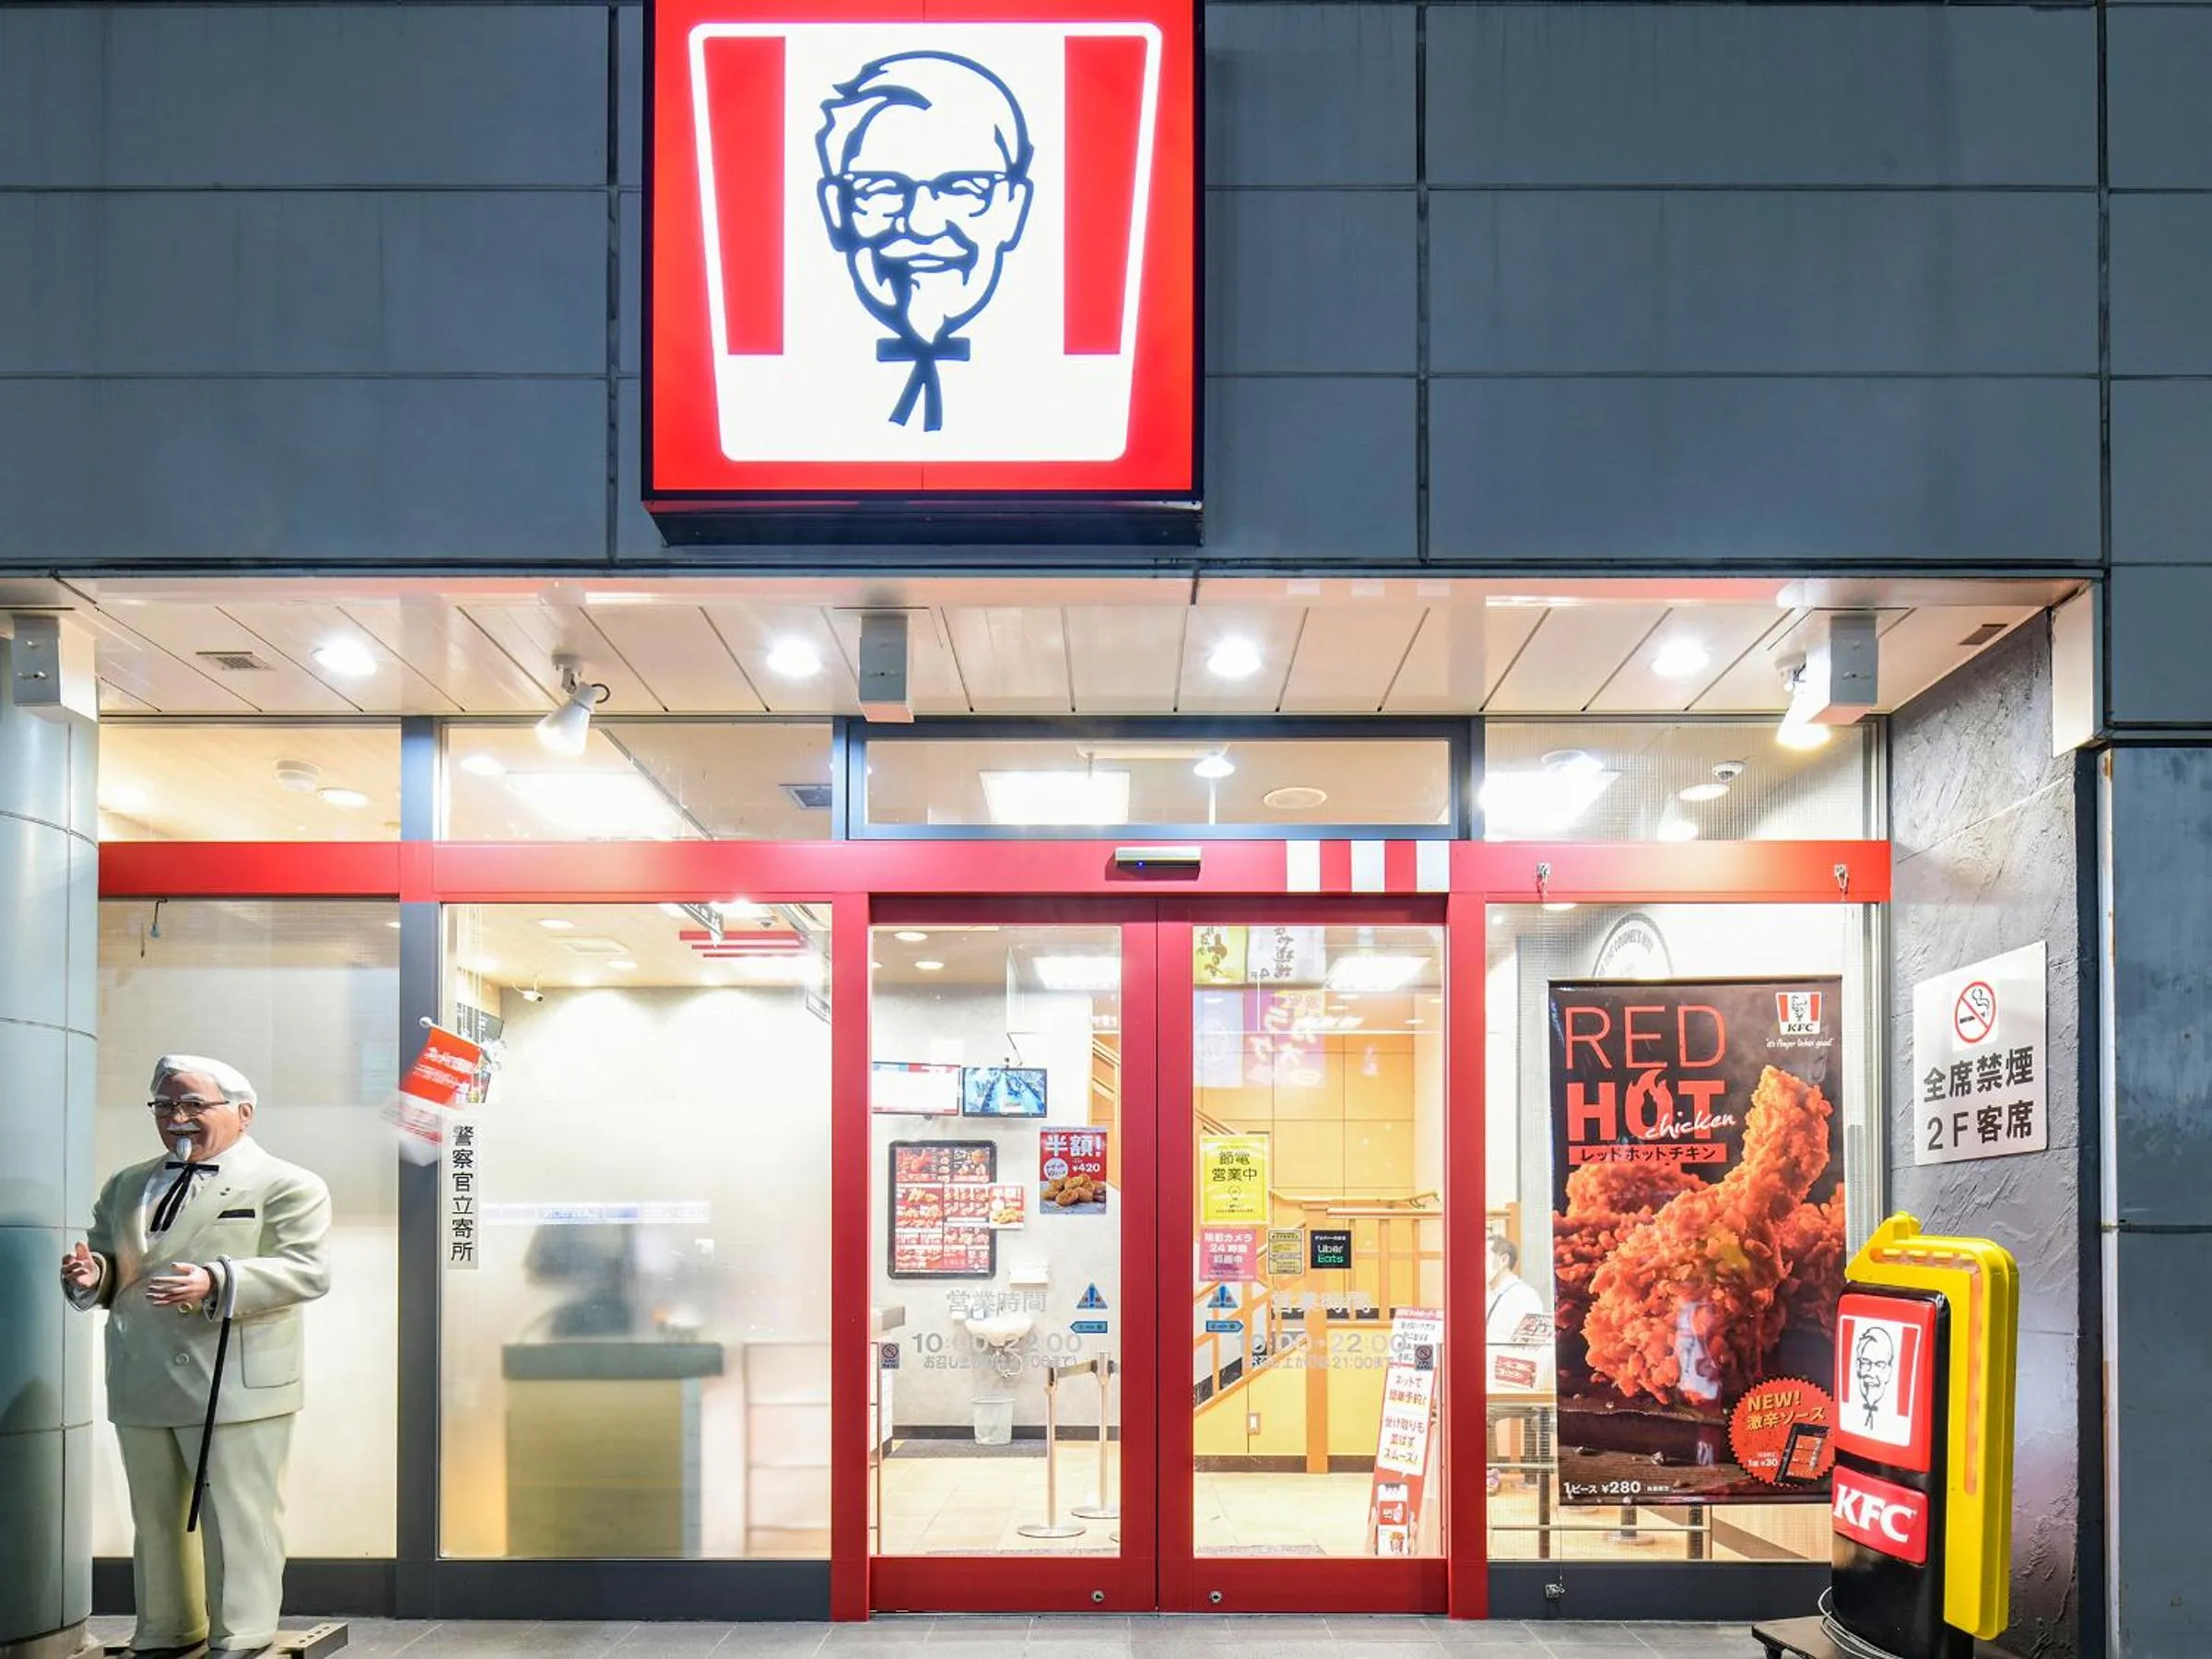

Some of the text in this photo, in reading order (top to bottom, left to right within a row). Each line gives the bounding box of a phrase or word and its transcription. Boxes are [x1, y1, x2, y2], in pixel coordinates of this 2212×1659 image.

[1564, 1005, 1725, 1069] RED
[1787, 1023, 1814, 1032] KFC
[1924, 1045, 2034, 1103] 全席禁煙
[1567, 1068, 1725, 1141] HOT
[1644, 1110, 1736, 1140] chicken
[1926, 1100, 2034, 1151] 2F客席
[1045, 1135, 1101, 1158] 半額!
[1218, 1150, 1251, 1166] 節電
[1581, 1145, 1716, 1162] レッドホットチキン
[1211, 1167, 1257, 1182] 営業中
[450, 1125, 474, 1262] 警察官立寄所
[1317, 1244, 1343, 1253] Uber
[1317, 1254, 1344, 1263] Eats
[946, 1289, 1047, 1313] 営業時間
[1747, 1390, 1801, 1412] NEW!
[1563, 1481, 1597, 1495] 1ピース
[1601, 1481, 1641, 1493] ¥280
[1832, 1483, 1915, 1543] KFC
